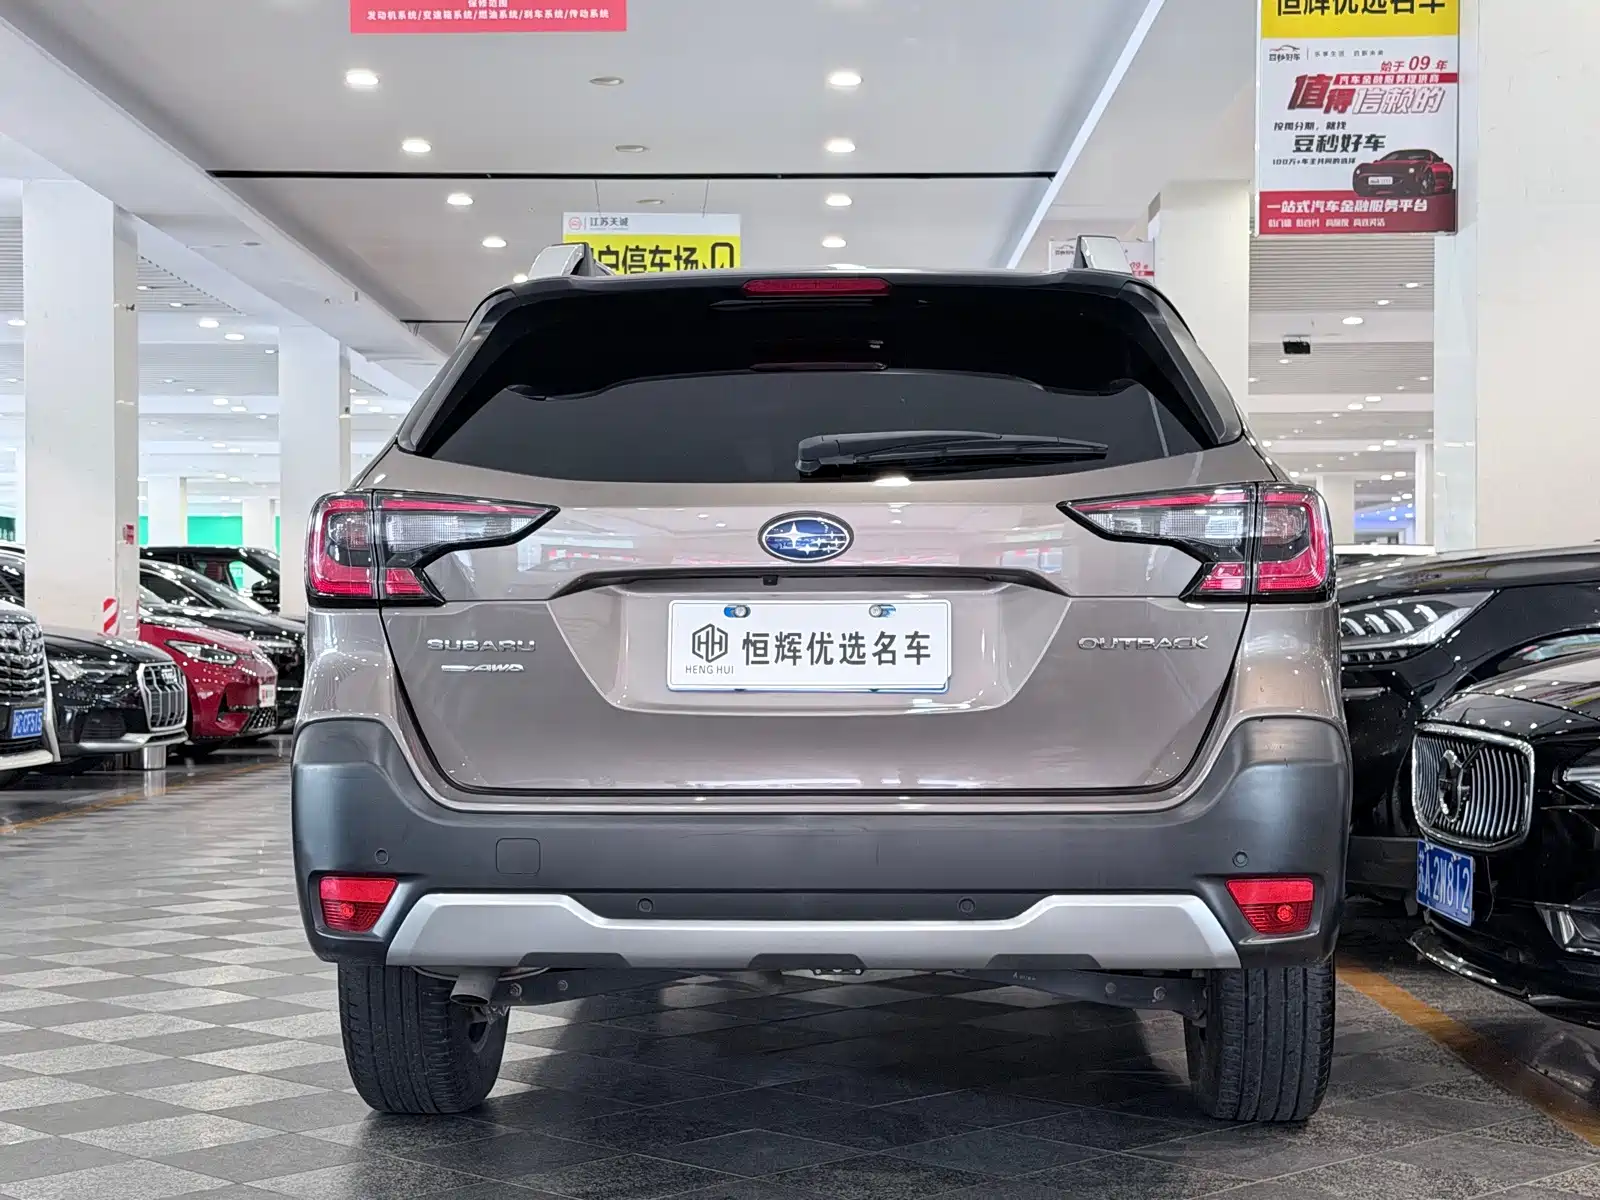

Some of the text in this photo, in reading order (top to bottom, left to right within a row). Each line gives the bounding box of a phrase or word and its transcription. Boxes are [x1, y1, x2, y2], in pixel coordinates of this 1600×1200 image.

[1380, 56, 1449, 72] 始于 09 年
[1292, 134, 1387, 153] 豆秒好车
[1266, 199, 1428, 214] 一站式汽车金融服务平台
[592, 244, 699, 275] 户停车场
[426, 638, 536, 652] SUBARU
[742, 631, 931, 666] 恒辉优选名车
[1078, 635, 1209, 650] OUTBACK
[685, 665, 734, 675] HENG HUI
